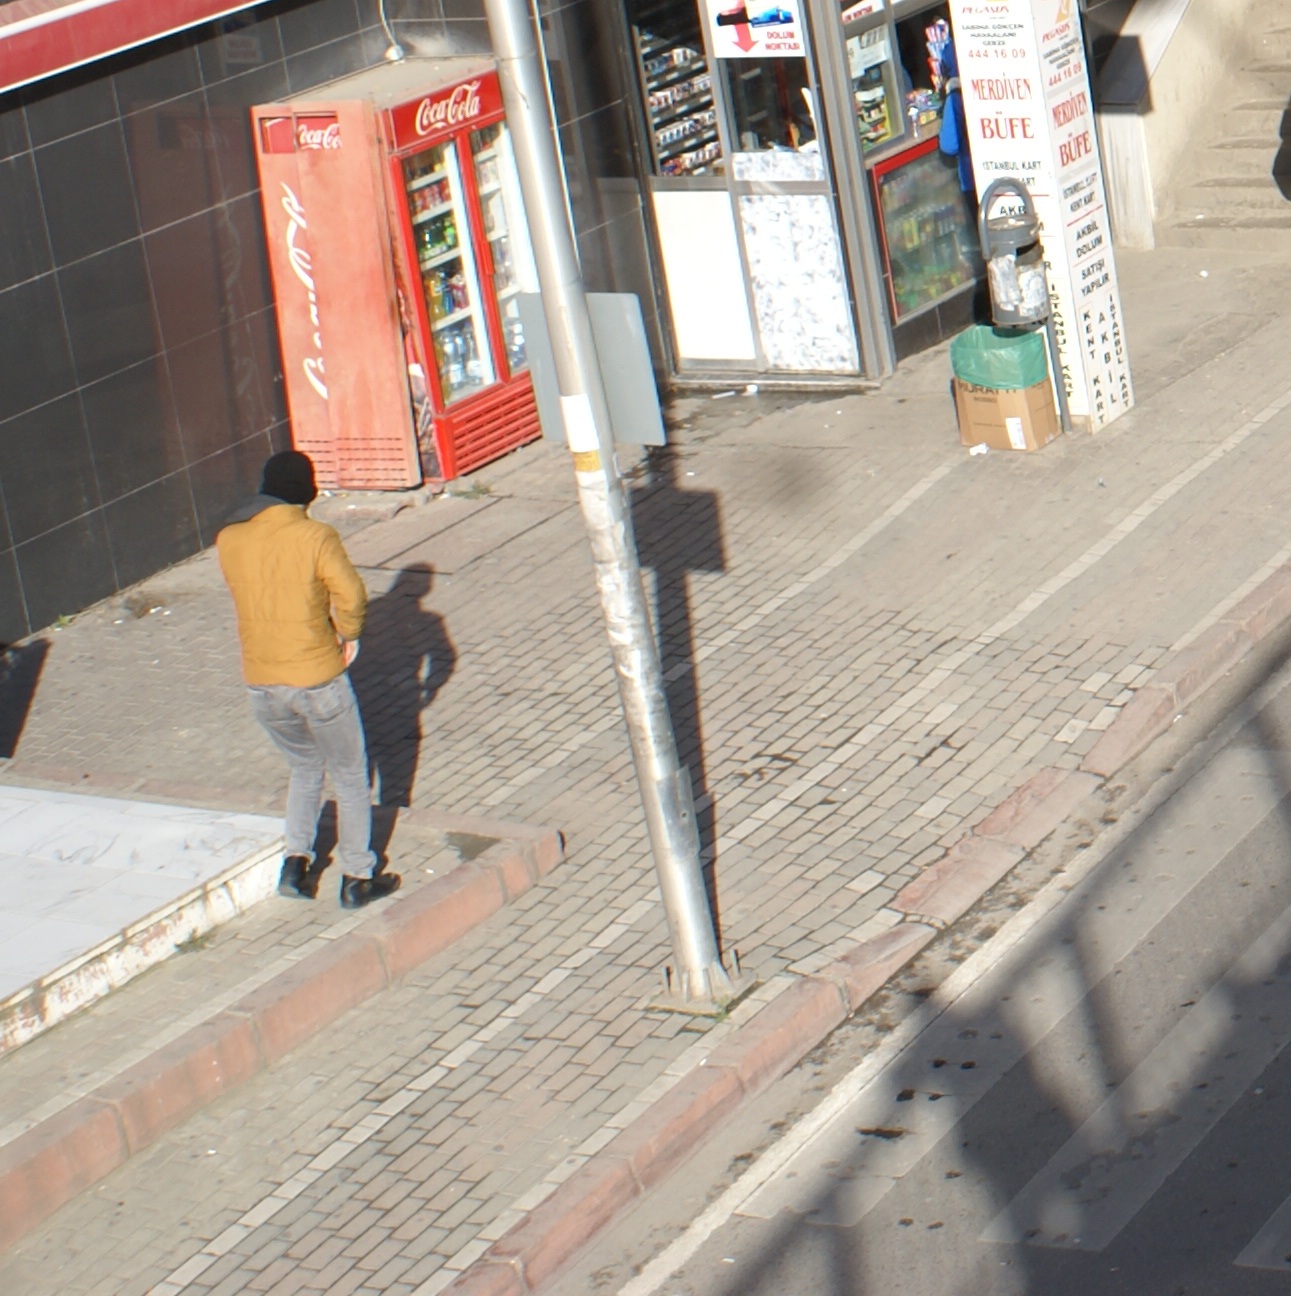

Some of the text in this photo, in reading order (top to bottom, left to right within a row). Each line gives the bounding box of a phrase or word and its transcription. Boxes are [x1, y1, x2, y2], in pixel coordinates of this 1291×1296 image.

[968, 48, 1026, 58] 444 16 09
[971, 72, 1032, 100] MERDİVEN
[1052, 90, 1089, 129] MERDİVEN
[980, 111, 1034, 139] BÜFE
[1059, 130, 1092, 168] BÜFE
[1022, 161, 1042, 170] KART
[1076, 234, 1103, 258] DOLUM
[1083, 310, 1106, 424] KENT KART
[1119, 373, 1131, 408] KART
